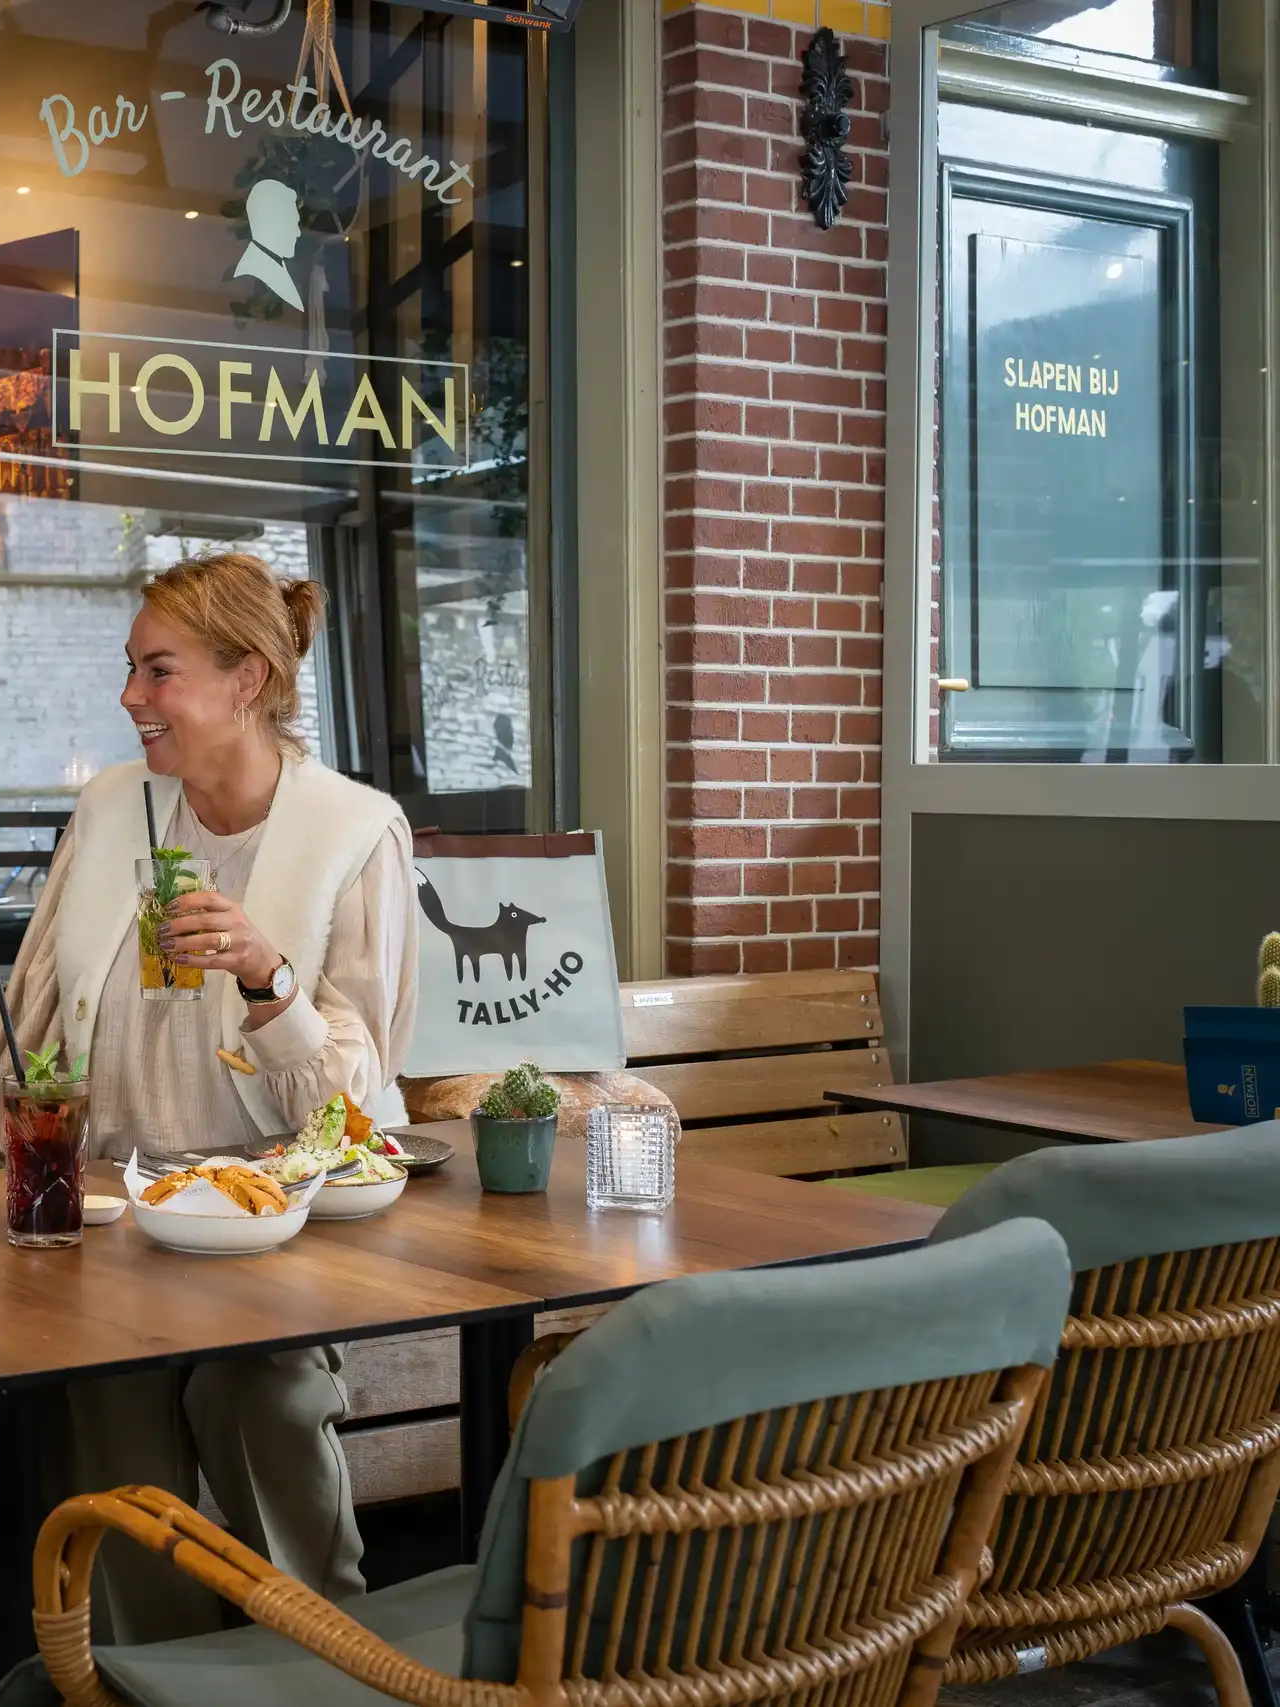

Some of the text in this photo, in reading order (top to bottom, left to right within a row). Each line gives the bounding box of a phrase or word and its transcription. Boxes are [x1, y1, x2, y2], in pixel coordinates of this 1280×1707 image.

[504, 13, 553, 29] Schwank
[39, 93, 148, 178] Bar
[204, 57, 475, 205] Restaurant
[69, 348, 455, 452] HOFMAN
[1004, 357, 1119, 396] SLAPEN BIJ
[1016, 402, 1106, 438] HOFMAN
[457, 951, 583, 1026] TALLY-HO
[1244, 1067, 1257, 1115] HOFMAN
